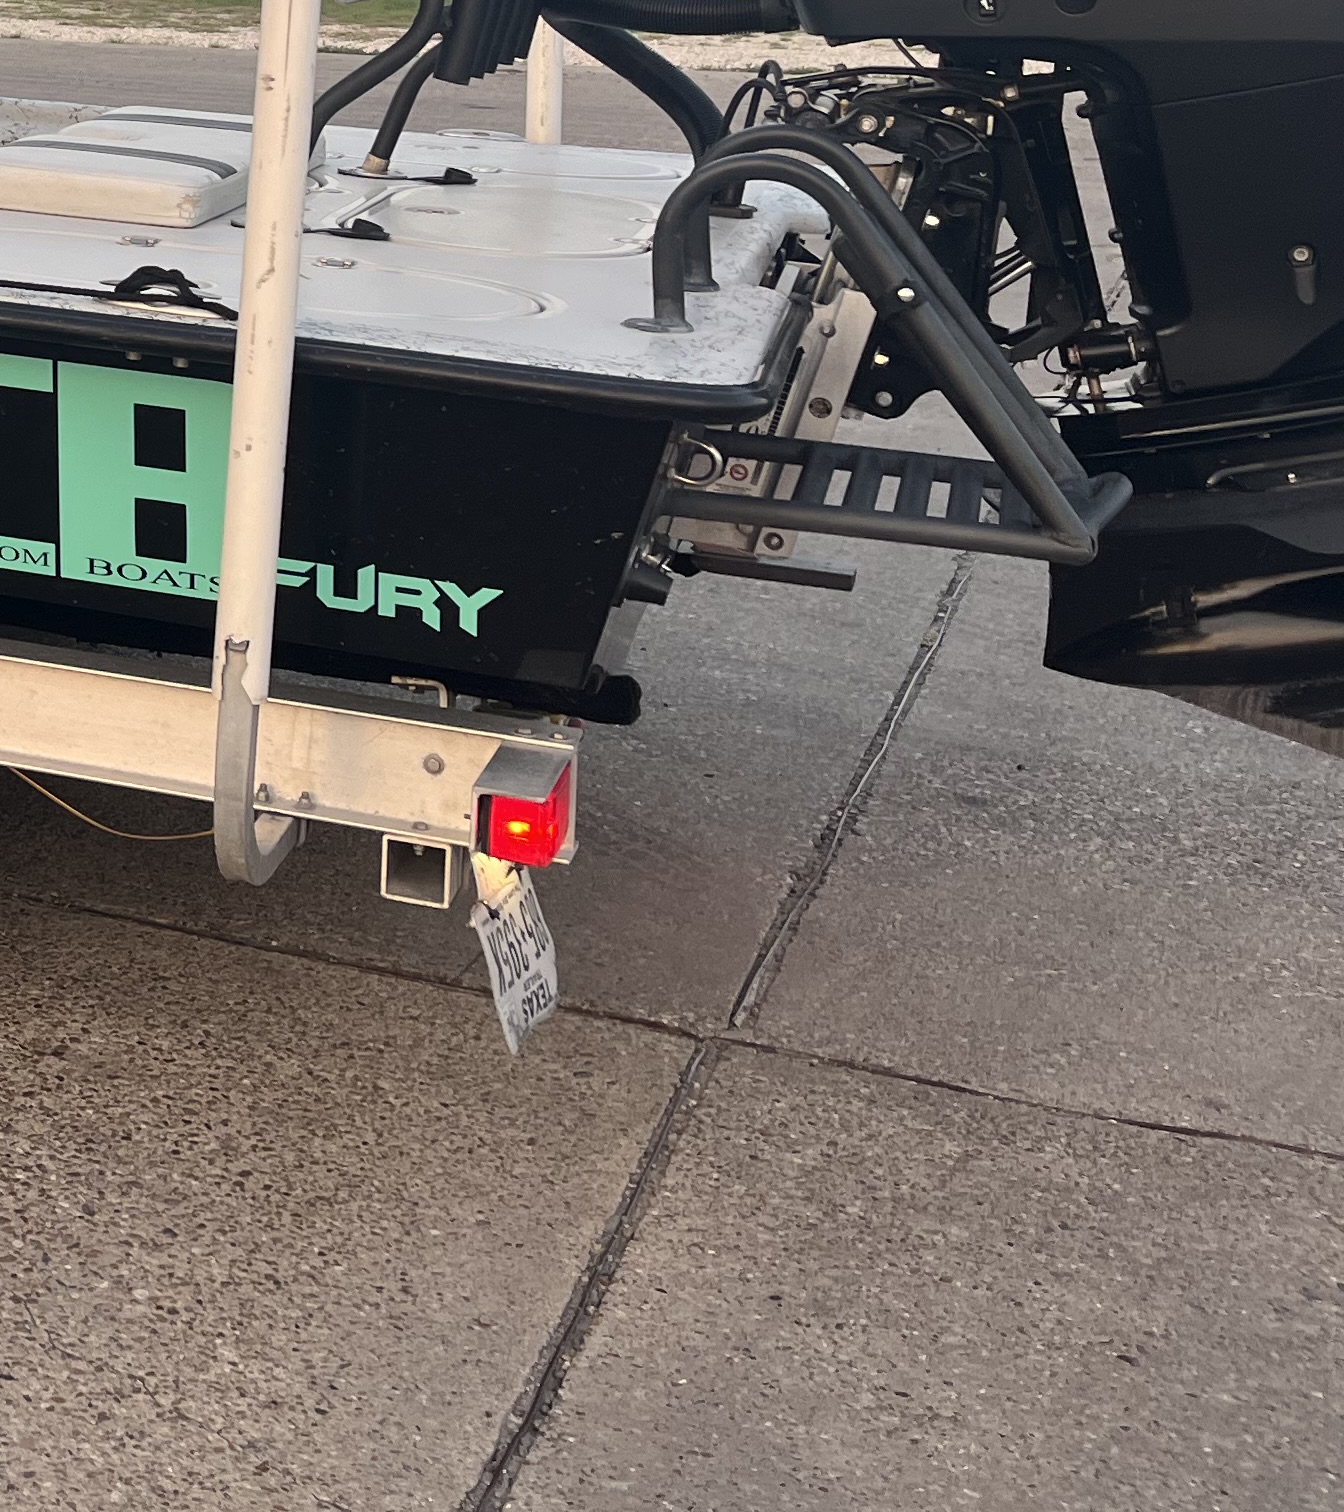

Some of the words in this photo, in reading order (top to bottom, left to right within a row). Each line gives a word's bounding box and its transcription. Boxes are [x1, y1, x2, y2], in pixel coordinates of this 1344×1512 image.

[85, 557, 220, 593] BOATS
[277, 557, 504, 637] FURY
[522, 978, 553, 1025] TEXAS
